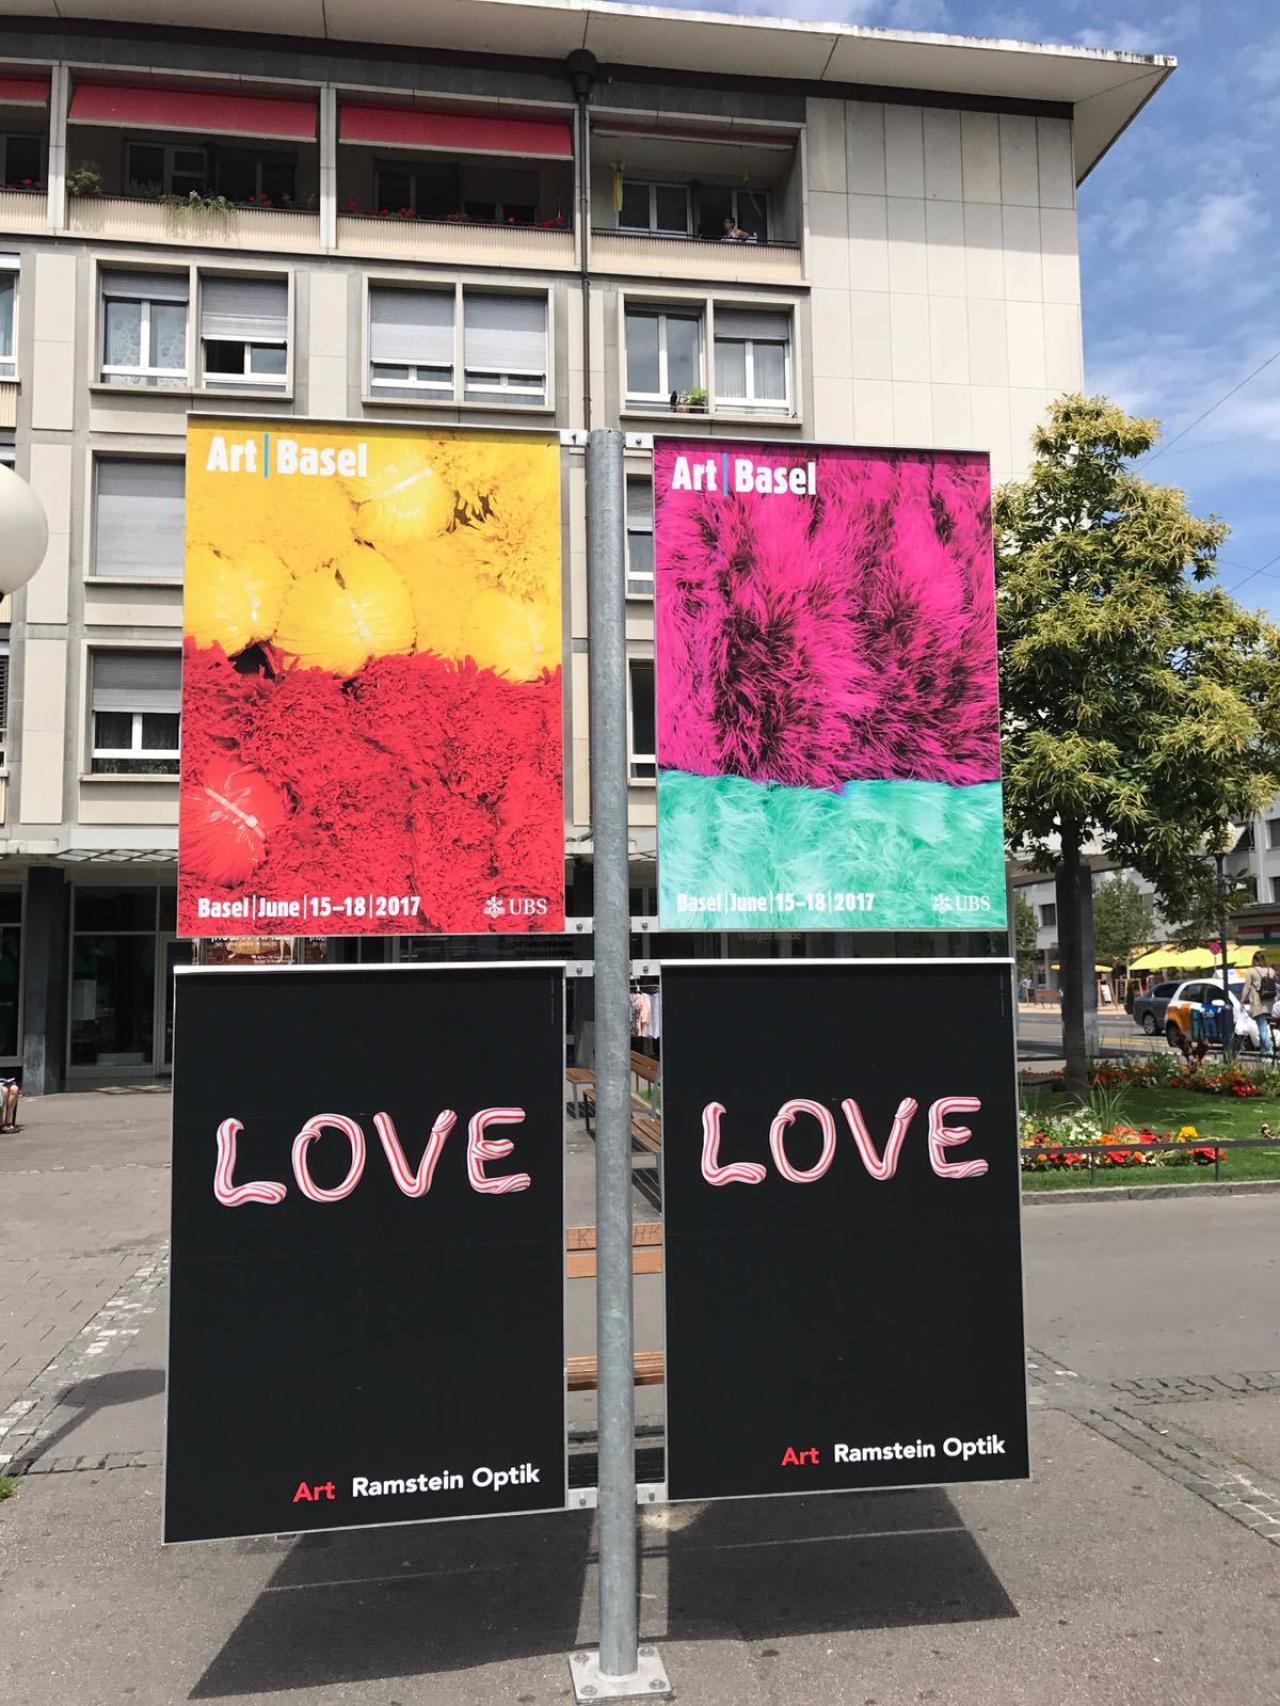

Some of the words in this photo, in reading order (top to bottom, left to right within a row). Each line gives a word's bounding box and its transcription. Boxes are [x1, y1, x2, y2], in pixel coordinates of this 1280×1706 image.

[206, 436, 257, 473] Art
[276, 439, 368, 478] Basel
[671, 456, 718, 492] Art
[734, 459, 817, 496] Basel
[197, 897, 249, 918] Basel
[258, 897, 300, 918] June
[375, 896, 421, 917] 2017
[509, 898, 548, 915] UBS
[677, 893, 721, 912] Basel
[729, 893, 767, 912] June
[834, 892, 875, 912] 2017
[955, 895, 991, 912] UBS
[213, 1106, 532, 1208] LOVE
[701, 1096, 989, 1187] LOVE
[781, 1446, 820, 1467] Art
[834, 1439, 936, 1464] Ramstein
[942, 1434, 1006, 1462] Optik
[292, 1481, 336, 1503] Art
[352, 1469, 464, 1498] Ramstein
[471, 1462, 541, 1492] Optik
